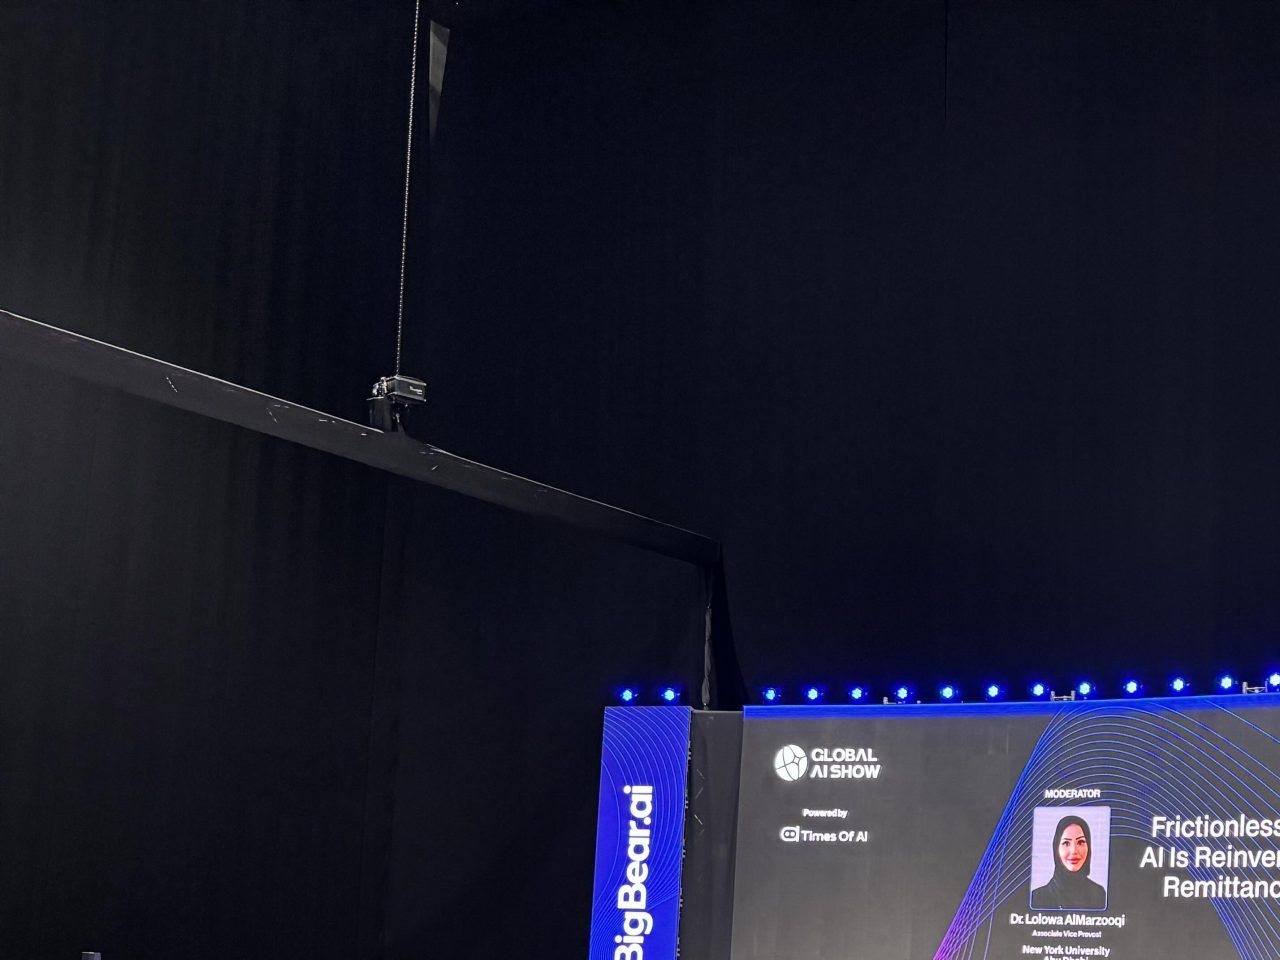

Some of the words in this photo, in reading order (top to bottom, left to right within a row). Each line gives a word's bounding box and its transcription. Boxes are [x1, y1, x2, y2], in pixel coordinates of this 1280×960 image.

[811, 748, 877, 761] GLOBAL
[810, 765, 827, 778] AI
[830, 765, 880, 778] SHOW
[1045, 788, 1100, 800] MODERATOR
[803, 809, 837, 817] Powered
[838, 809, 847, 818] by
[801, 831, 836, 841] Times
[839, 831, 854, 841] Of
[856, 831, 867, 841] AI
[1140, 847, 1162, 868] AI
[1170, 846, 1188, 868] Is
[1011, 914, 1023, 924] Dr.
[1026, 913, 1063, 925] Lolowa
[1065, 914, 1125, 928] AlMarzooqi
[1023, 945, 1042, 954] New
[1044, 945, 1064, 954] York
[1065, 946, 1110, 957] University
